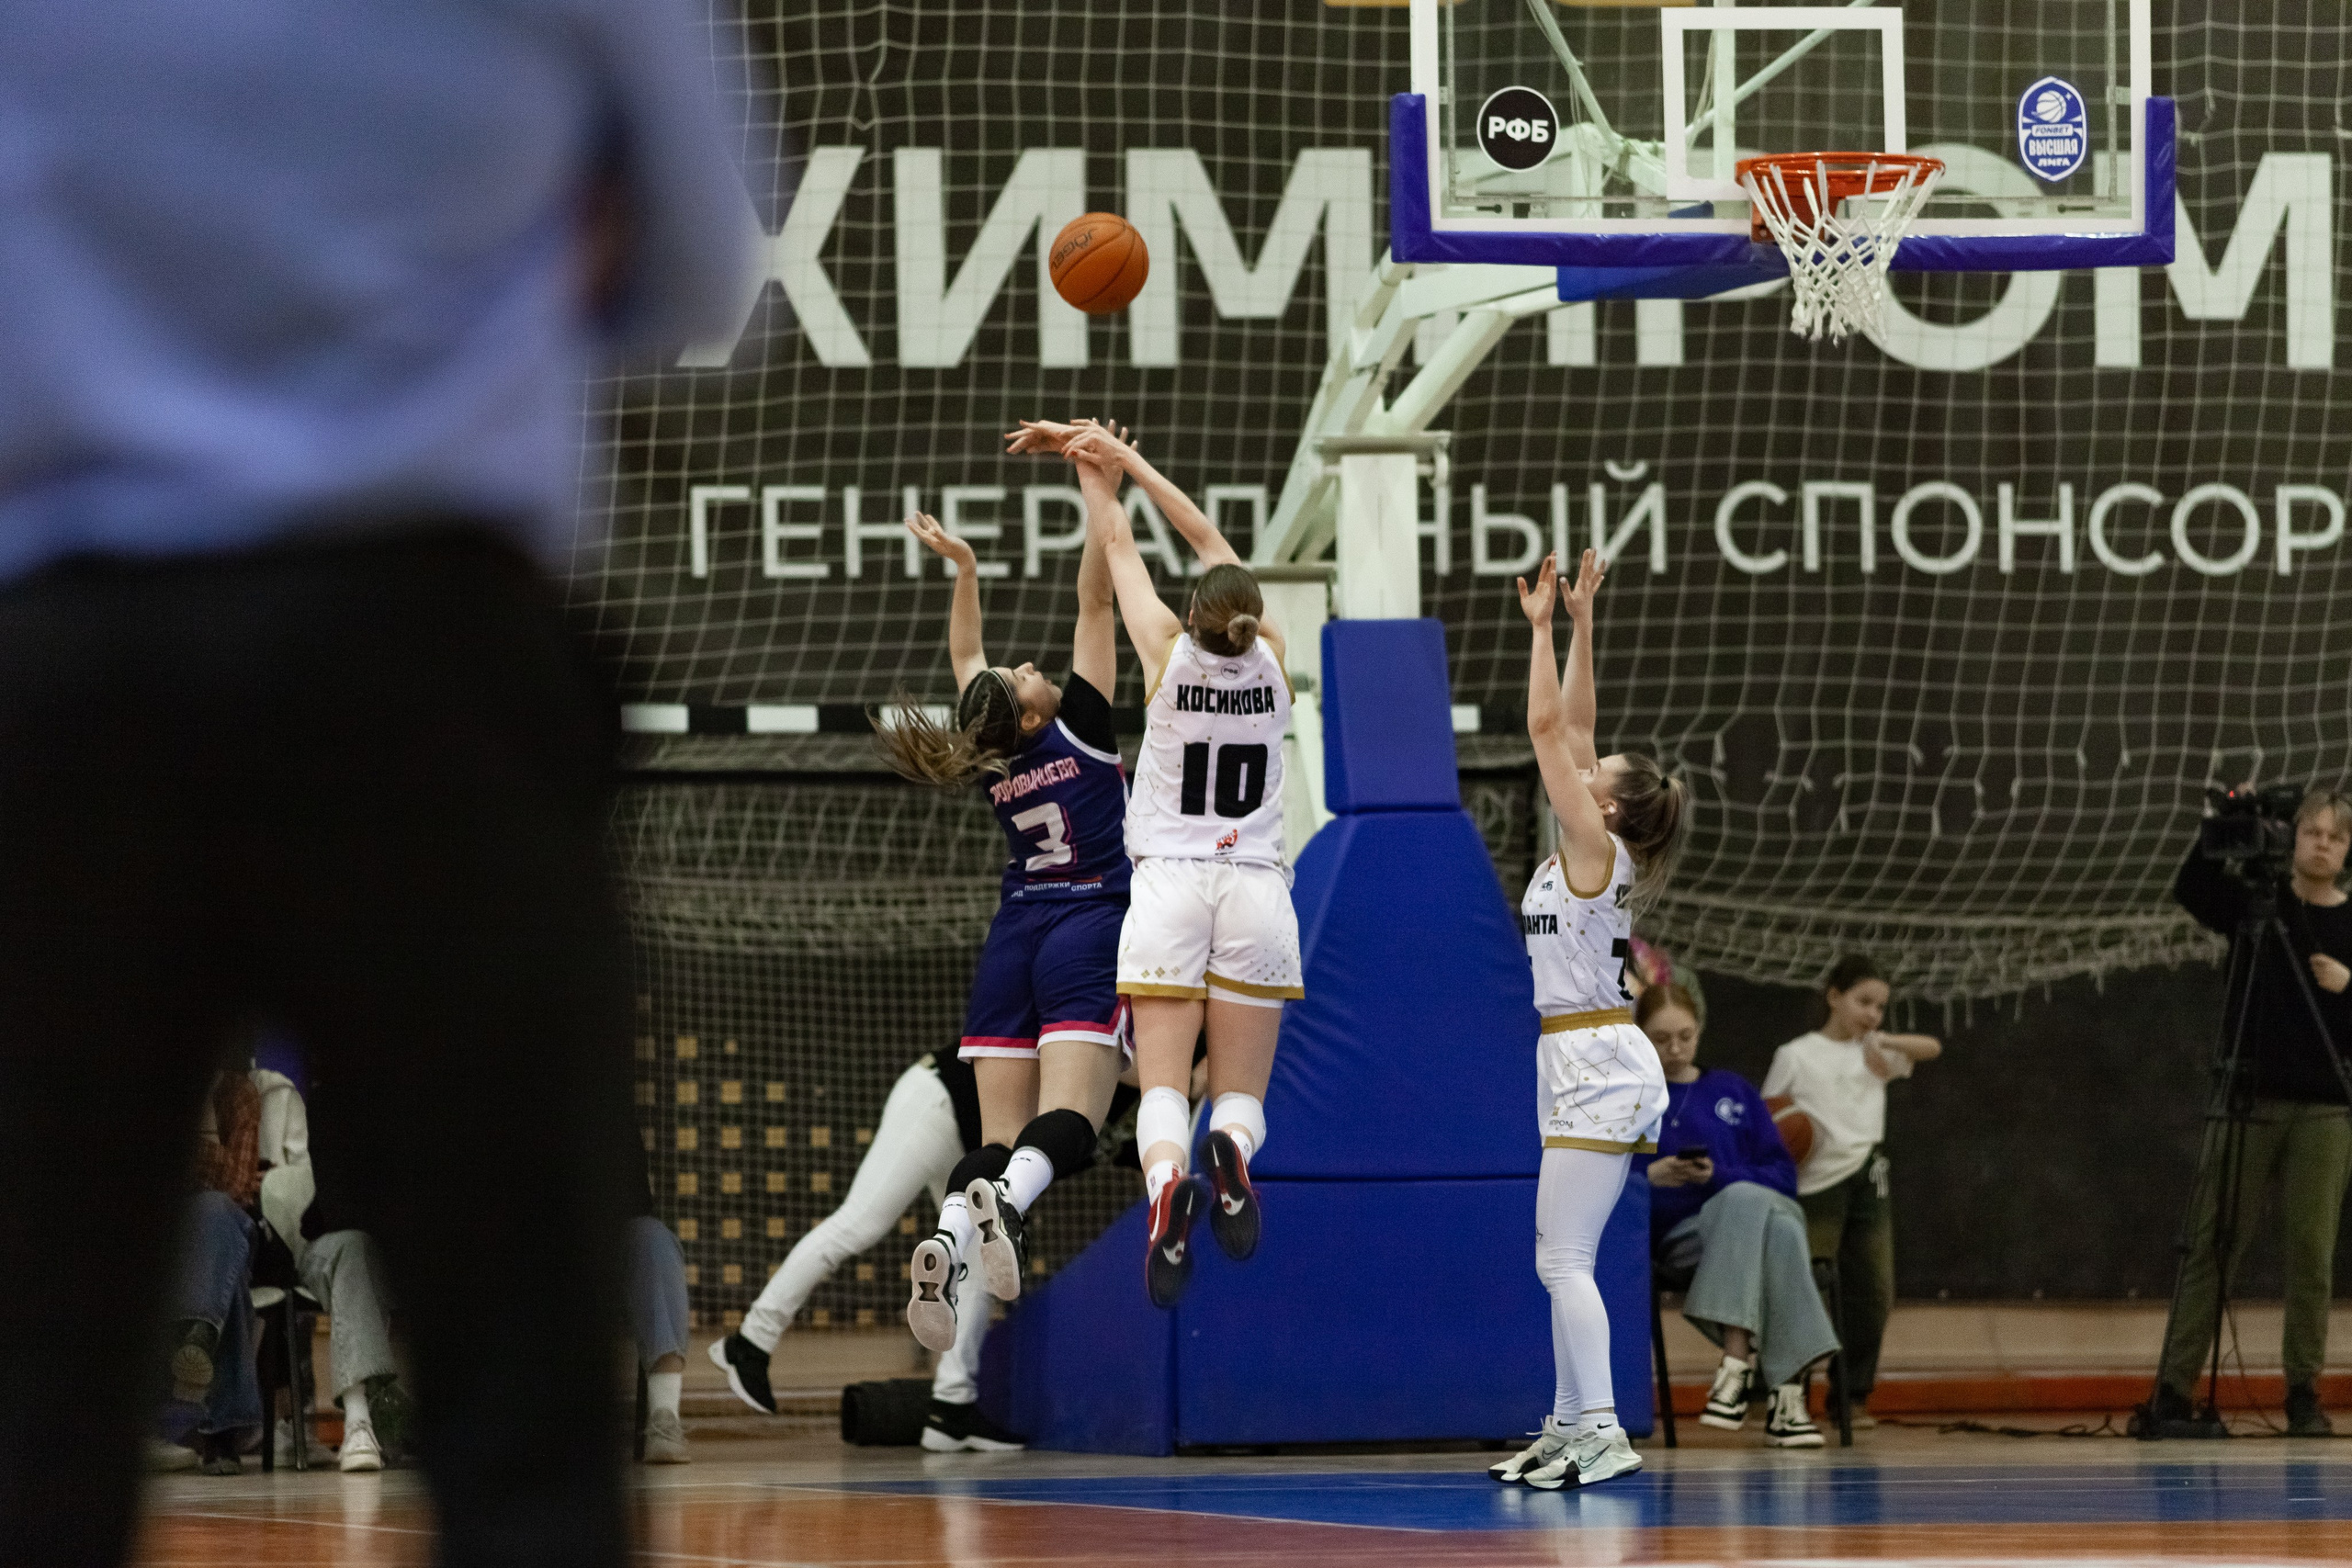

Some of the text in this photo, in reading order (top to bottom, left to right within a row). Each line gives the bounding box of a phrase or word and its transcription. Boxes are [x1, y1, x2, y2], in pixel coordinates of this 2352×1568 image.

[1487, 116, 1549, 142] РФБ
[2029, 138, 2078, 156] ВЫСШАЯ
[2038, 157, 2071, 166] ЛИГА
[691, 460, 2345, 579] ГЕНЕРАЛНЫЙ СПОНСОР
[1177, 684, 1275, 716] КОСИКОВА
[1181, 741, 1268, 818] 10
[1011, 802, 1076, 872] 3
[1024, 882, 1070, 891] ПОДДЕРЖКИ
[1070, 882, 1102, 892] СПОРТА
[1523, 914, 1558, 935] АНТА
